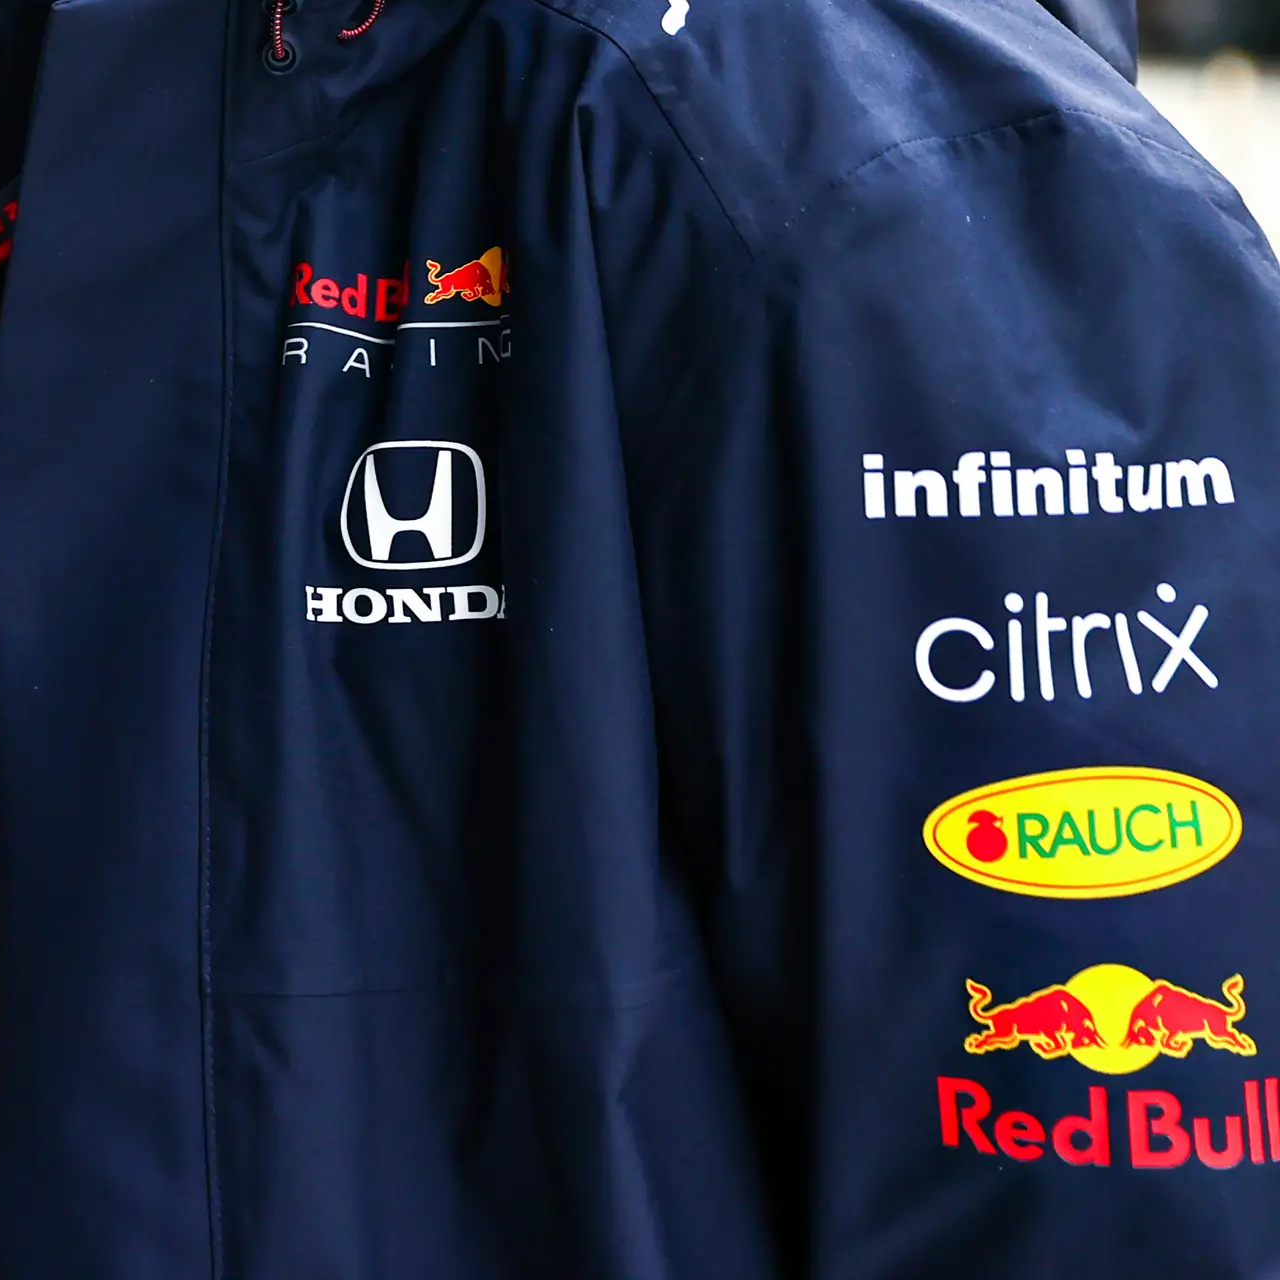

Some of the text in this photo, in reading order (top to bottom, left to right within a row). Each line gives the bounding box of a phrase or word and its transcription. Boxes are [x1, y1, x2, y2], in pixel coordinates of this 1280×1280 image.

[290, 261, 368, 320] Red
[282, 328, 512, 379] RAING
[862, 449, 1236, 520] infinitum
[915, 582, 1219, 703] citrix
[1017, 800, 1203, 860] RAUCH
[937, 1075, 1280, 1170] Red Bull
